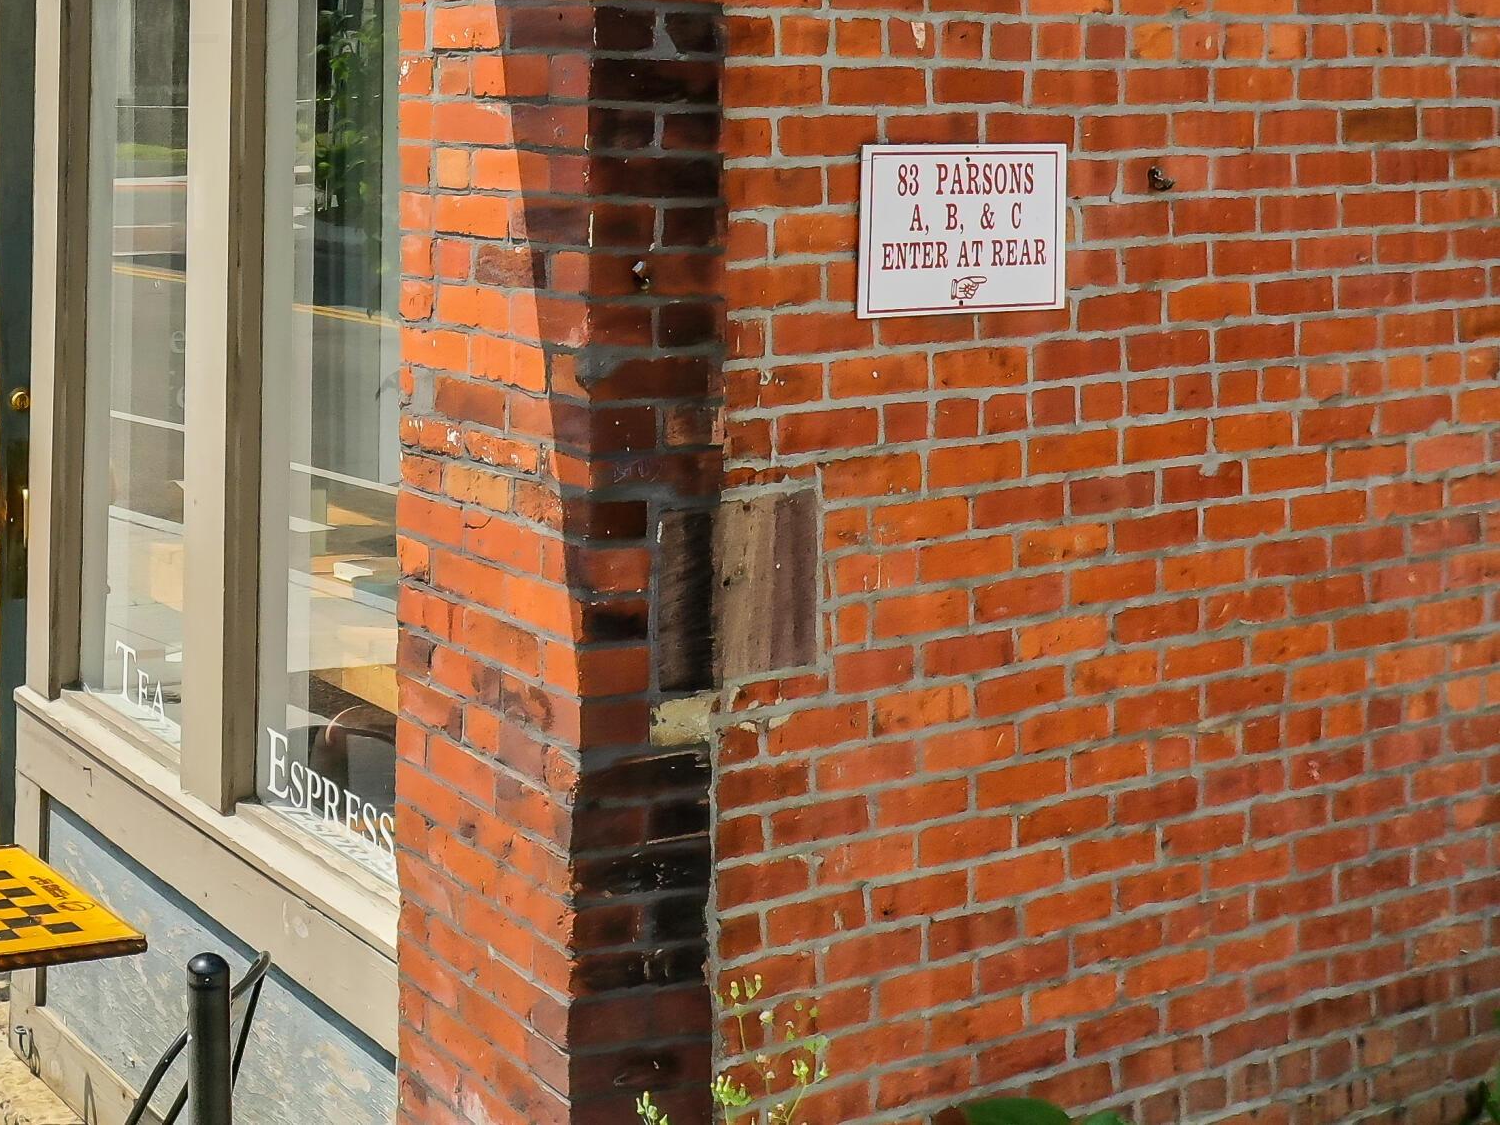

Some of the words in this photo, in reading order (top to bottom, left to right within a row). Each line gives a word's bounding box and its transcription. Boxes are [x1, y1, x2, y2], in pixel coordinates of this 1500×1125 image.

[897, 164, 919, 196] 83
[935, 162, 1034, 195] PARSONS
[909, 204, 929, 235] A,
[945, 203, 964, 235] B,
[980, 202, 995, 230] &
[1011, 202, 1022, 230] C
[881, 241, 948, 270] ENTER
[956, 240, 983, 267] AT
[990, 239, 1047, 267] REAR
[115, 640, 165, 722] TEA
[266, 727, 395, 859] ESPRESS
